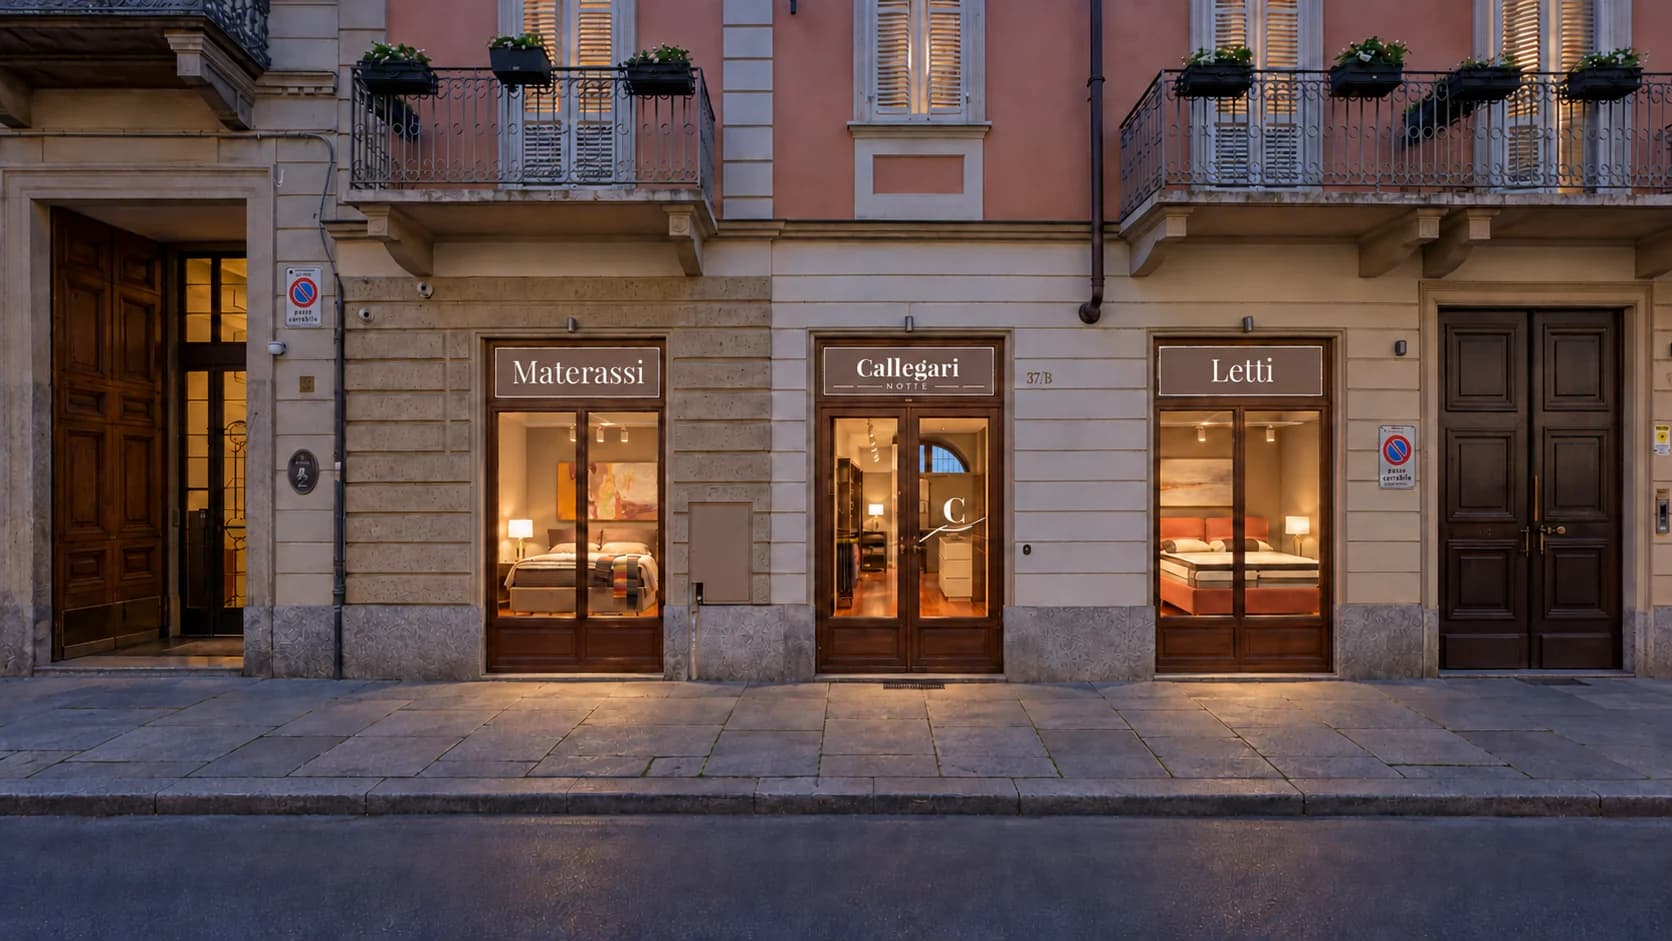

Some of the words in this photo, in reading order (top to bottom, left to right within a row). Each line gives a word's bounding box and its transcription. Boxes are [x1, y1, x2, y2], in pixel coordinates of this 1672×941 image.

[512, 359, 645, 385] Materassi
[856, 357, 960, 381] Callegari
[1026, 371, 1053, 385] 37/B
[1211, 357, 1274, 383] Letti
[886, 382, 928, 390] NOTTE
[943, 497, 965, 524] C
